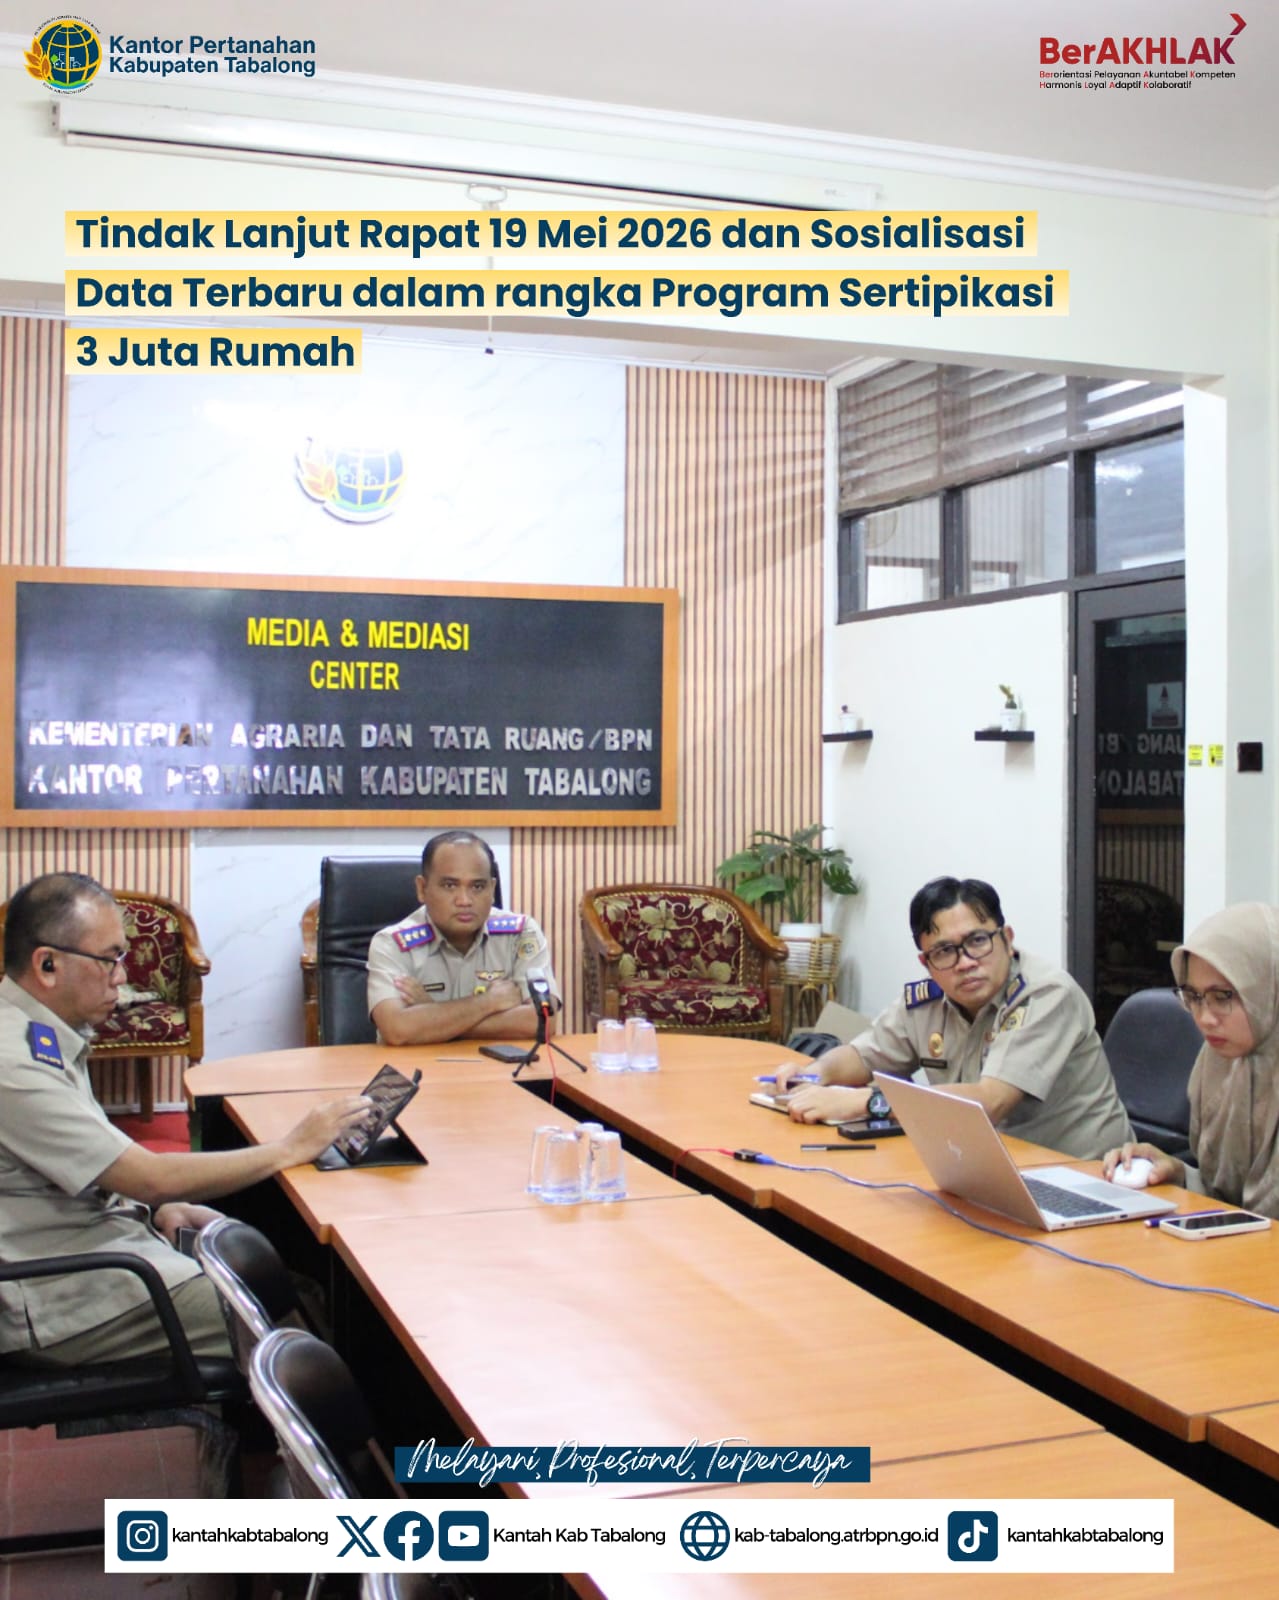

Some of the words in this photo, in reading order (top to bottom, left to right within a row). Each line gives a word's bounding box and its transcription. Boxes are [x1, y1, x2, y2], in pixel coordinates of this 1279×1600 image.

[247, 617, 330, 647] MEDIA
[340, 618, 359, 648] &
[368, 620, 470, 651] MEDIASI
[310, 661, 400, 691] CENTER
[29, 721, 213, 748] KEMENTERIAN
[231, 722, 345, 749] AGRARIA
[361, 724, 413, 748] DAN
[430, 726, 491, 750] TATA
[28, 763, 143, 795] KANTOR
[166, 764, 344, 795] PERTANAHAN
[361, 765, 508, 796] KABUPATEN
[525, 767, 652, 797] TABALONG
